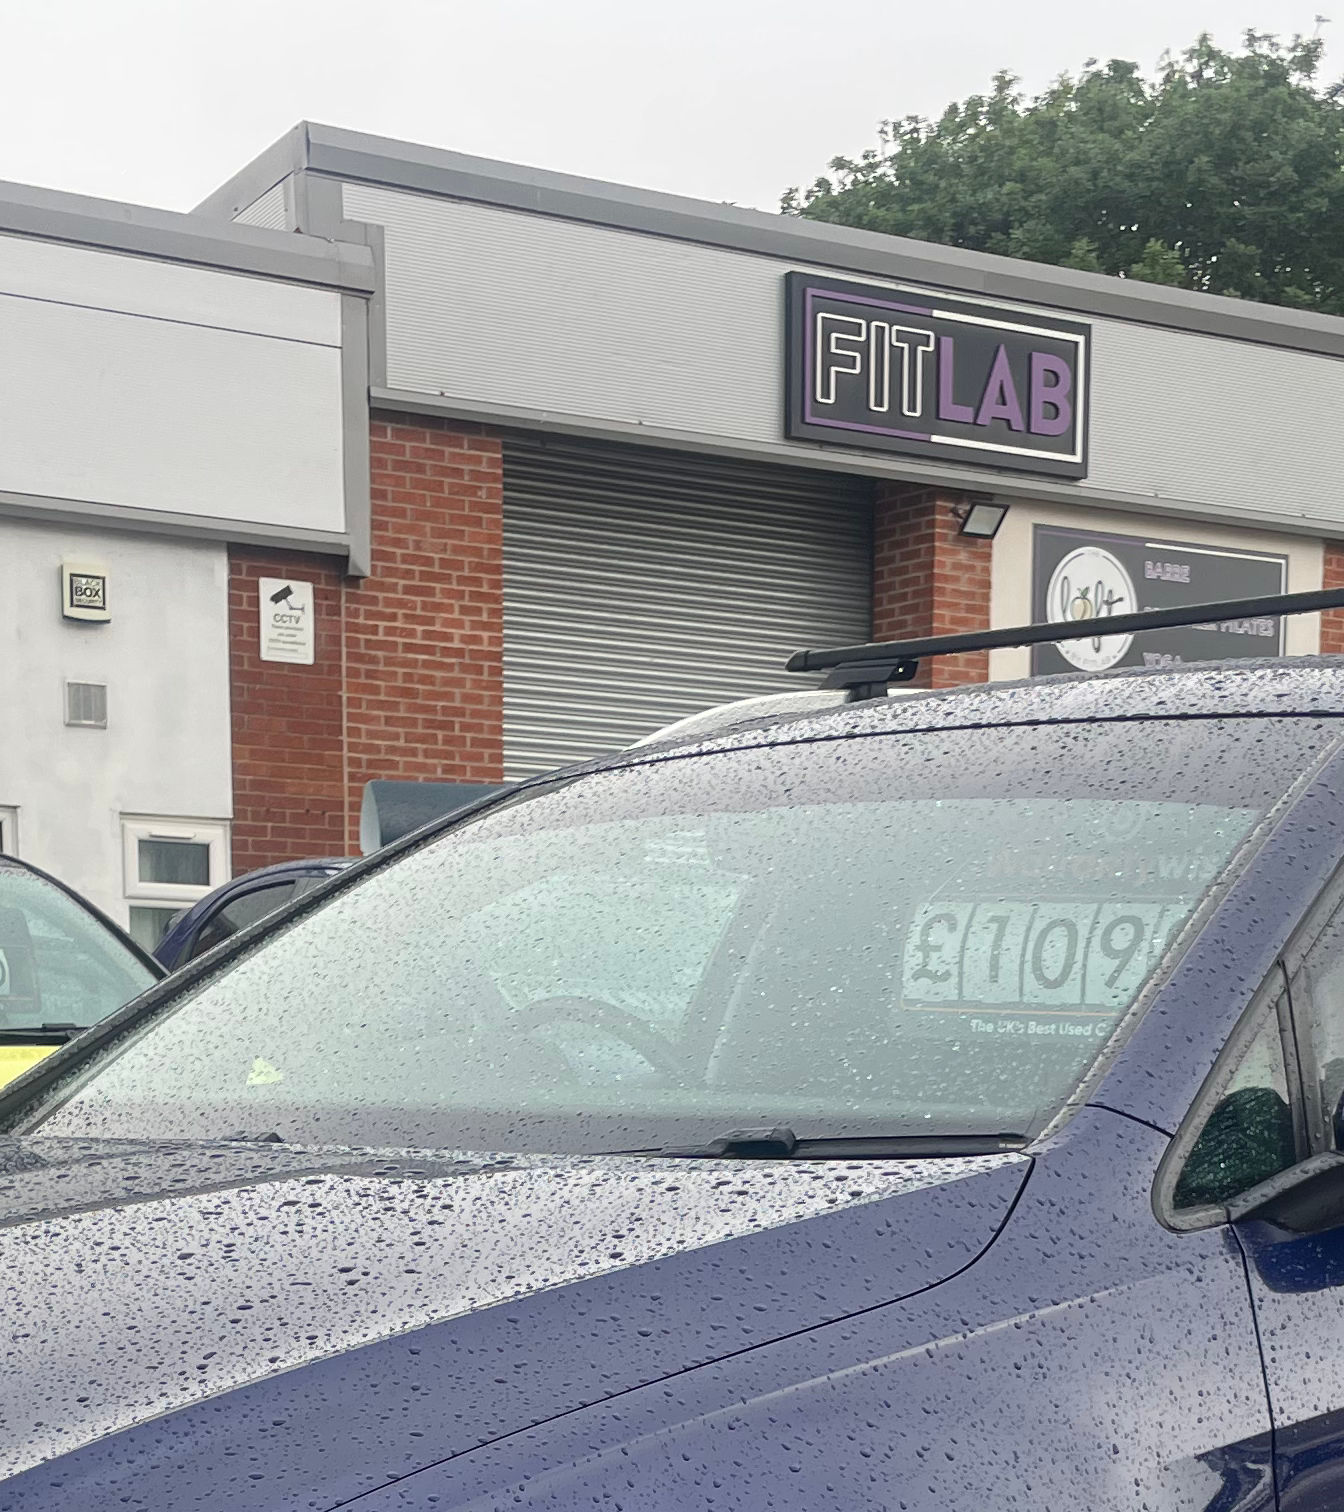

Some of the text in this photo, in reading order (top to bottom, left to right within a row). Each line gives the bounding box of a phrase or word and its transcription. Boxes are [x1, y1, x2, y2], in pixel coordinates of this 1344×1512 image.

[815, 312, 1072, 436] FITLAB
[74, 586, 102, 599] BOX
[272, 613, 301, 625] CCTV
[970, 1019, 994, 1033] The
[1027, 1021, 1056, 1035] Best
[1059, 1022, 1093, 1036] Used
